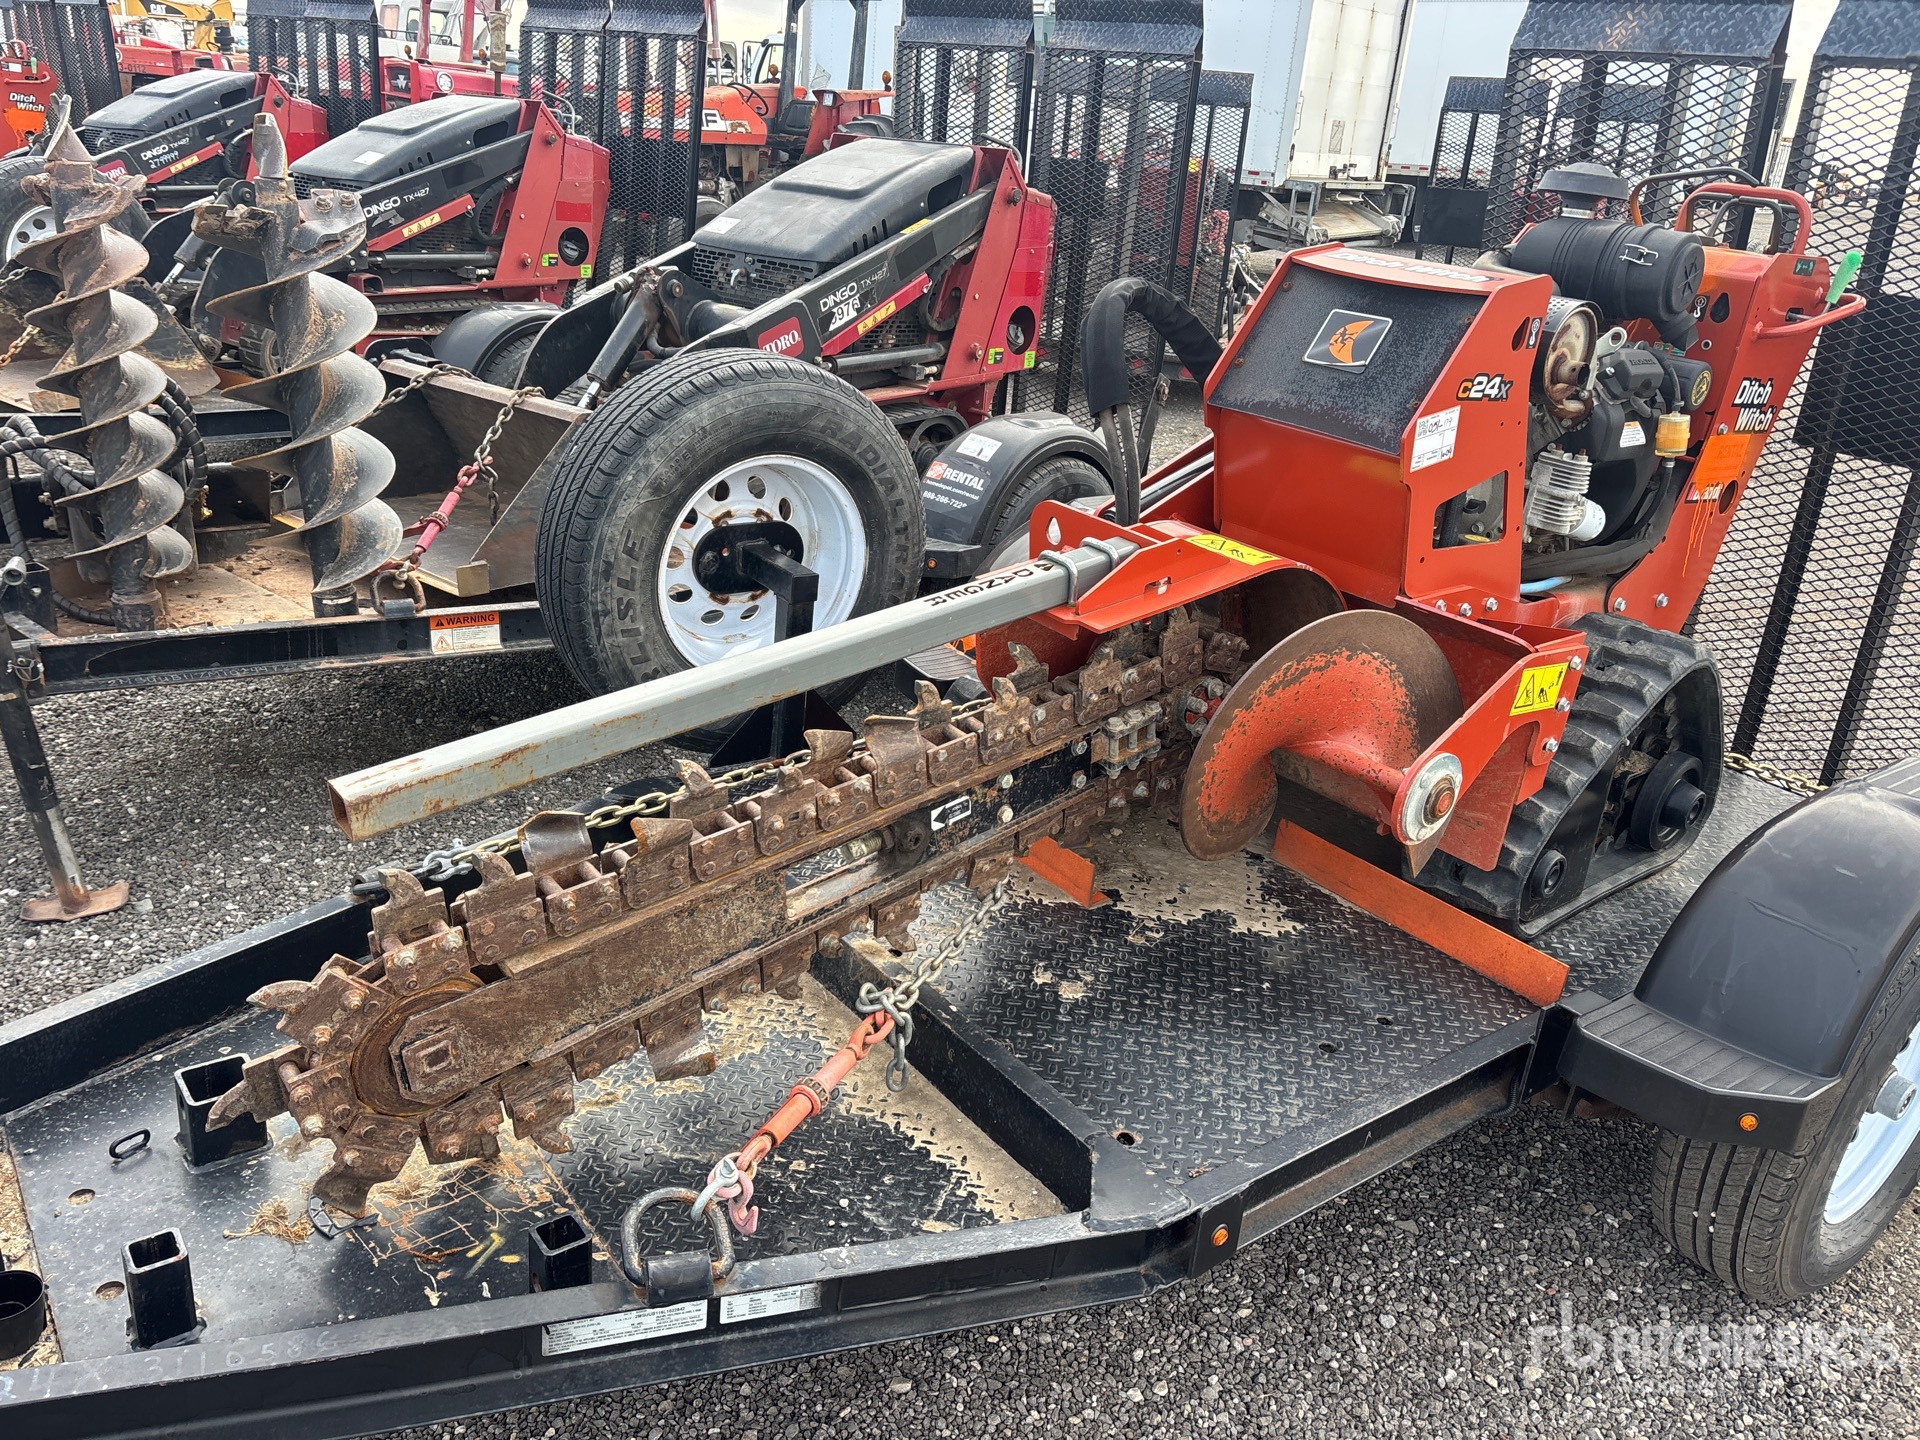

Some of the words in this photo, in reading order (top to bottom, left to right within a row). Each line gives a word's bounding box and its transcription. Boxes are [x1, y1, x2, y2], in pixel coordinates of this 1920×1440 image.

[149, 4, 167, 15] CAT
[9, 92, 37, 104] Ditch
[16, 101, 46, 113] Witch
[140, 144, 169, 161] DINGO
[363, 196, 401, 218] DINGO
[819, 282, 858, 313] DINGO
[762, 329, 801, 354] TORO
[1733, 379, 1773, 405] Ditch
[1734, 406, 1774, 432] Witch
[943, 467, 984, 491] RENTAL
[923, 568, 1035, 607] DANGER
[446, 613, 496, 626] WARNING
